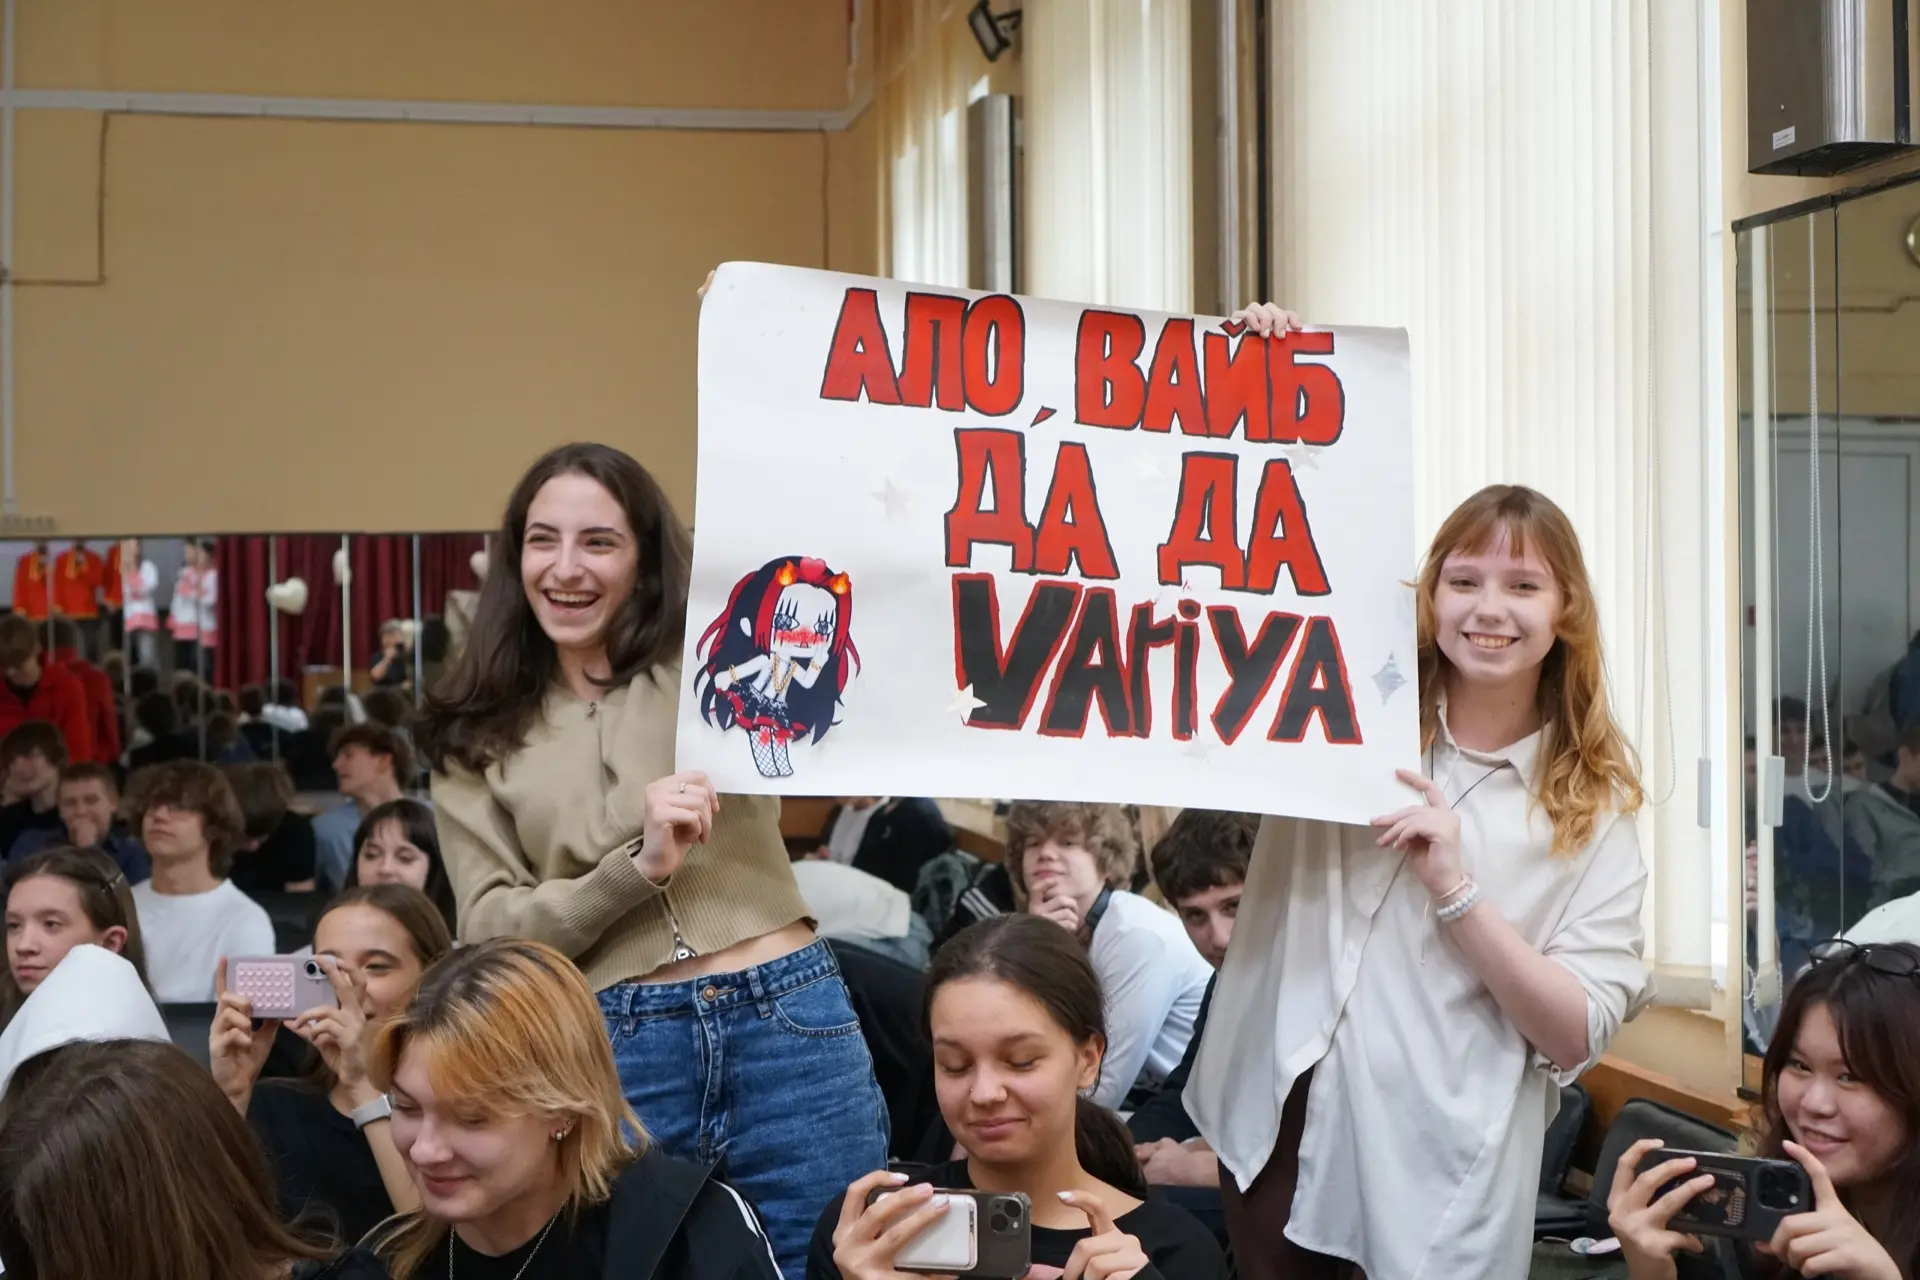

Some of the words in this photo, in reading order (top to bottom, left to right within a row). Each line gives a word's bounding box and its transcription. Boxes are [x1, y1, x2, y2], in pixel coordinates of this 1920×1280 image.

[820, 287, 1057, 428] АЛО,
[1074, 309, 1345, 446] ВАЙБ
[944, 428, 1120, 579] ДА
[1157, 451, 1331, 596] ДА
